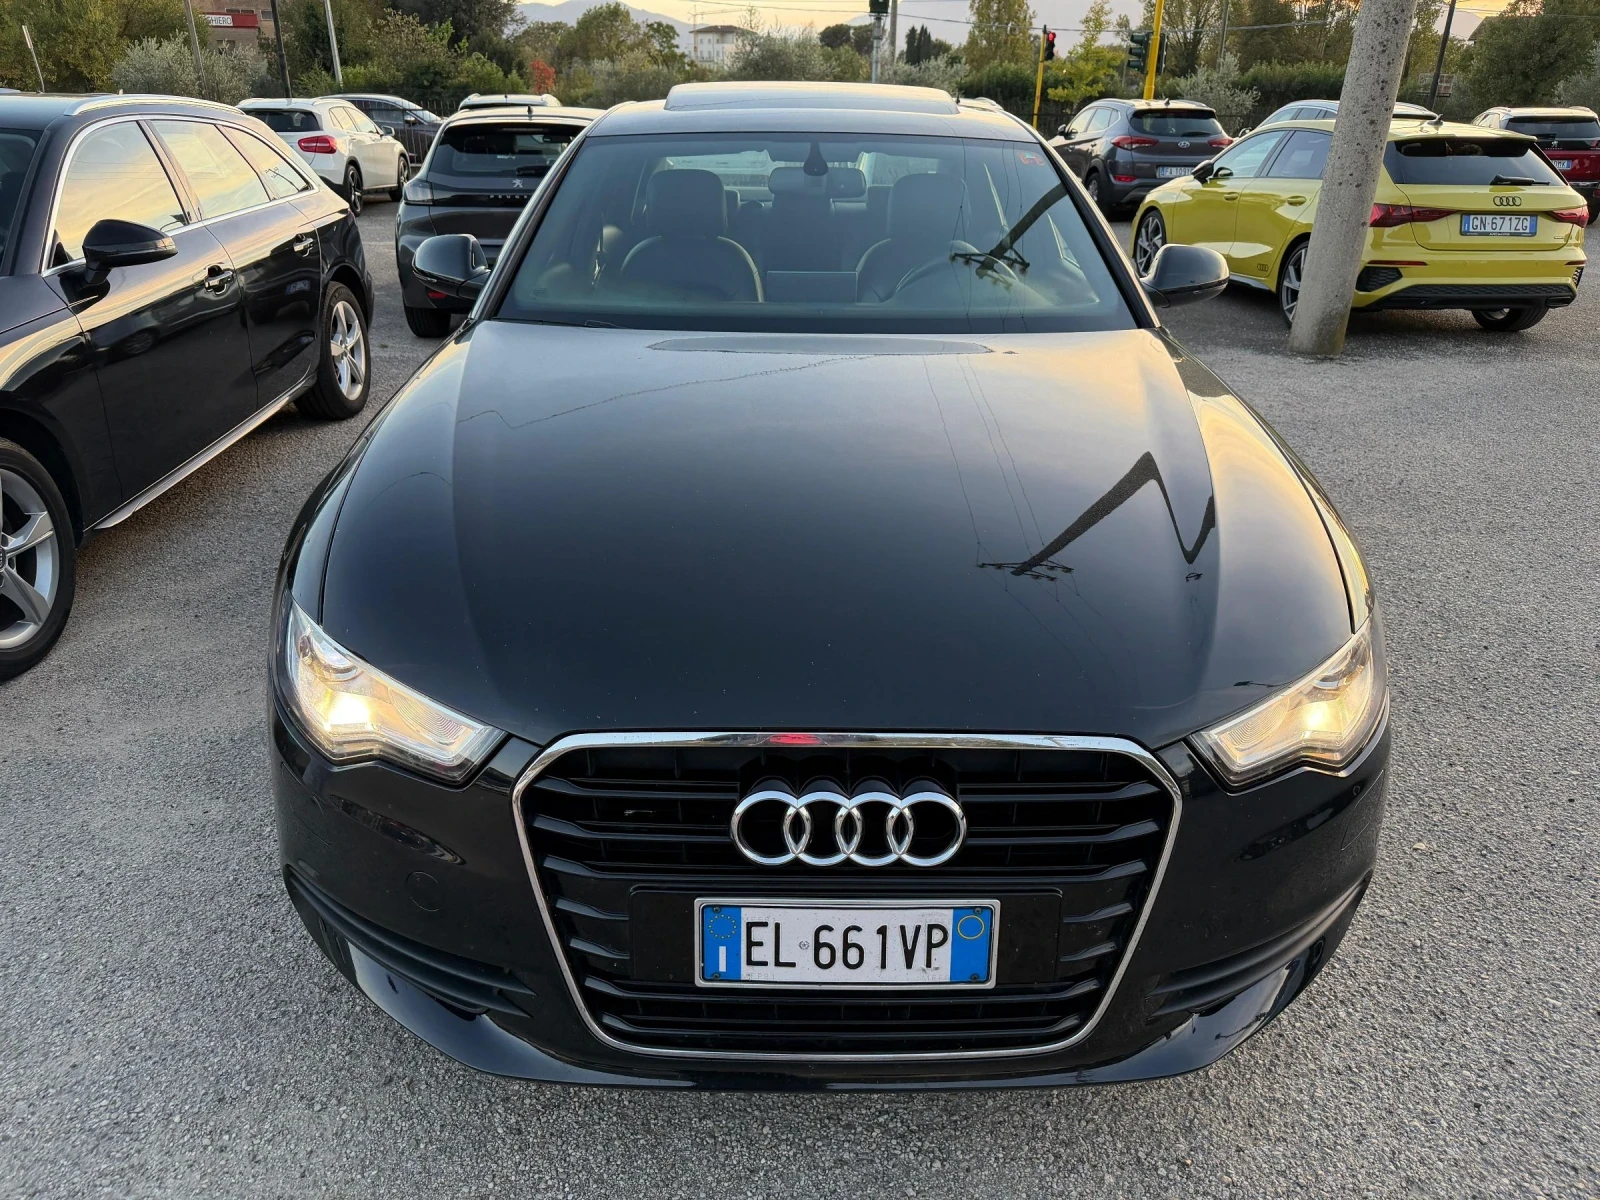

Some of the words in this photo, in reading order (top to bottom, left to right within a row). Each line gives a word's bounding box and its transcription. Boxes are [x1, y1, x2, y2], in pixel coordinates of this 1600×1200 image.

[1471, 216, 1487, 231] GN
[1490, 216, 1529, 231] 671ZG
[745, 921, 797, 968] EL
[812, 923, 949, 970] 661VP
